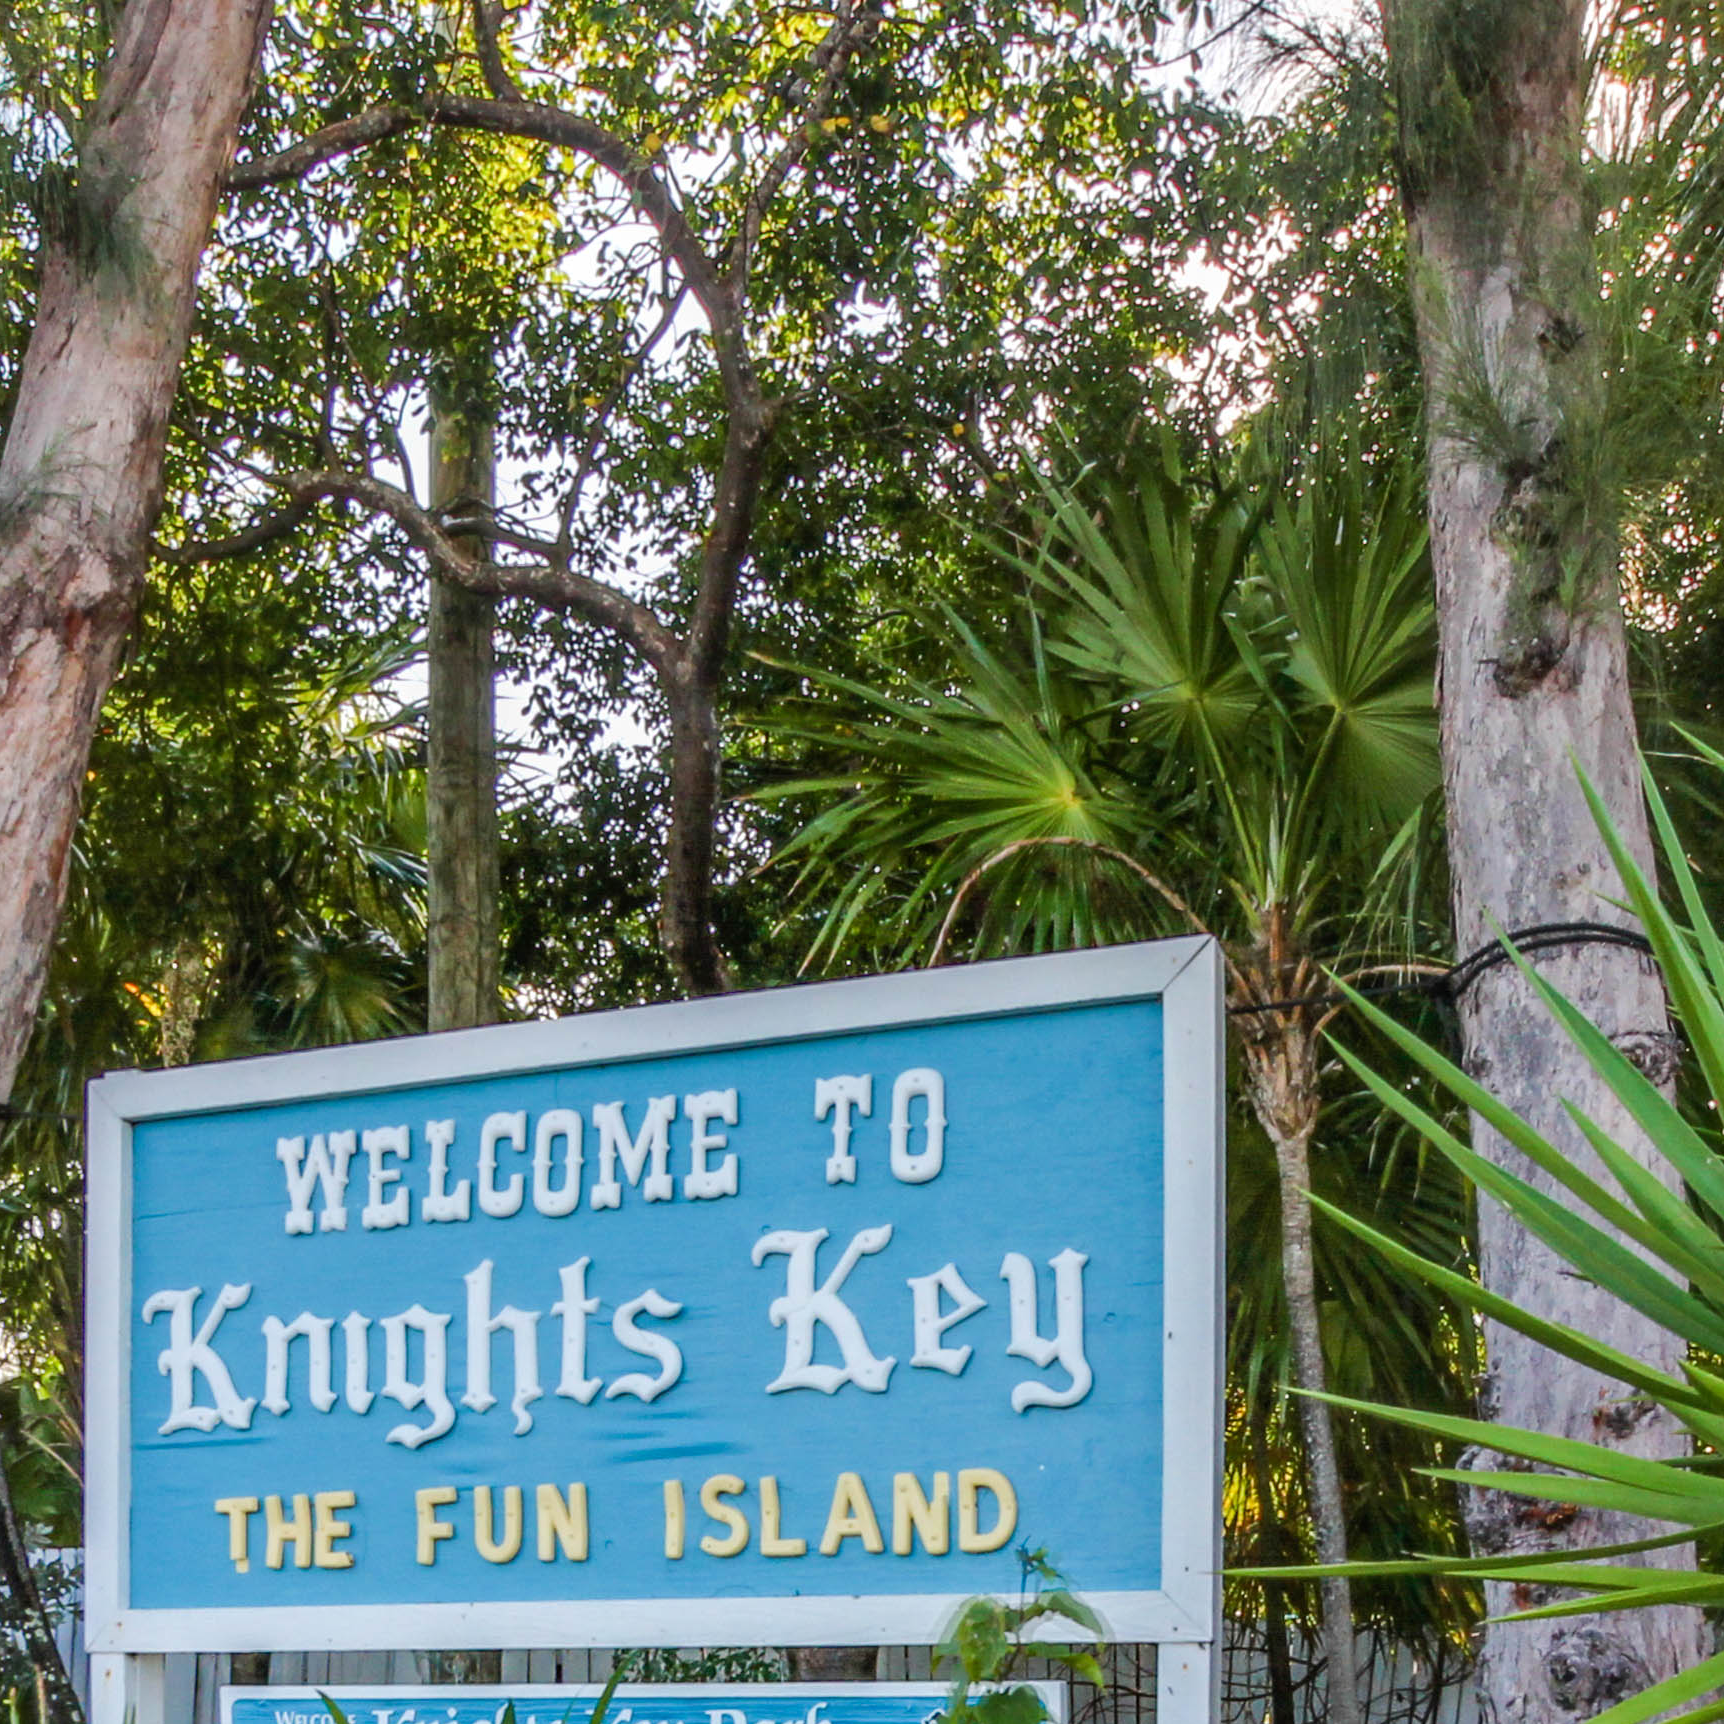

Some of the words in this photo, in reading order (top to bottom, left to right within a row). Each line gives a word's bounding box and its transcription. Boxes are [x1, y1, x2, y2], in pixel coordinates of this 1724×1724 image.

[277, 1088, 738, 1235] WELCOME
[815, 1068, 948, 1184] TO
[142, 1256, 684, 1449] Knights
[751, 1224, 1093, 1414] Key
[214, 1490, 356, 1573] THE
[415, 1482, 589, 1566] FUN
[664, 1469, 1019, 1559] ISLAND
